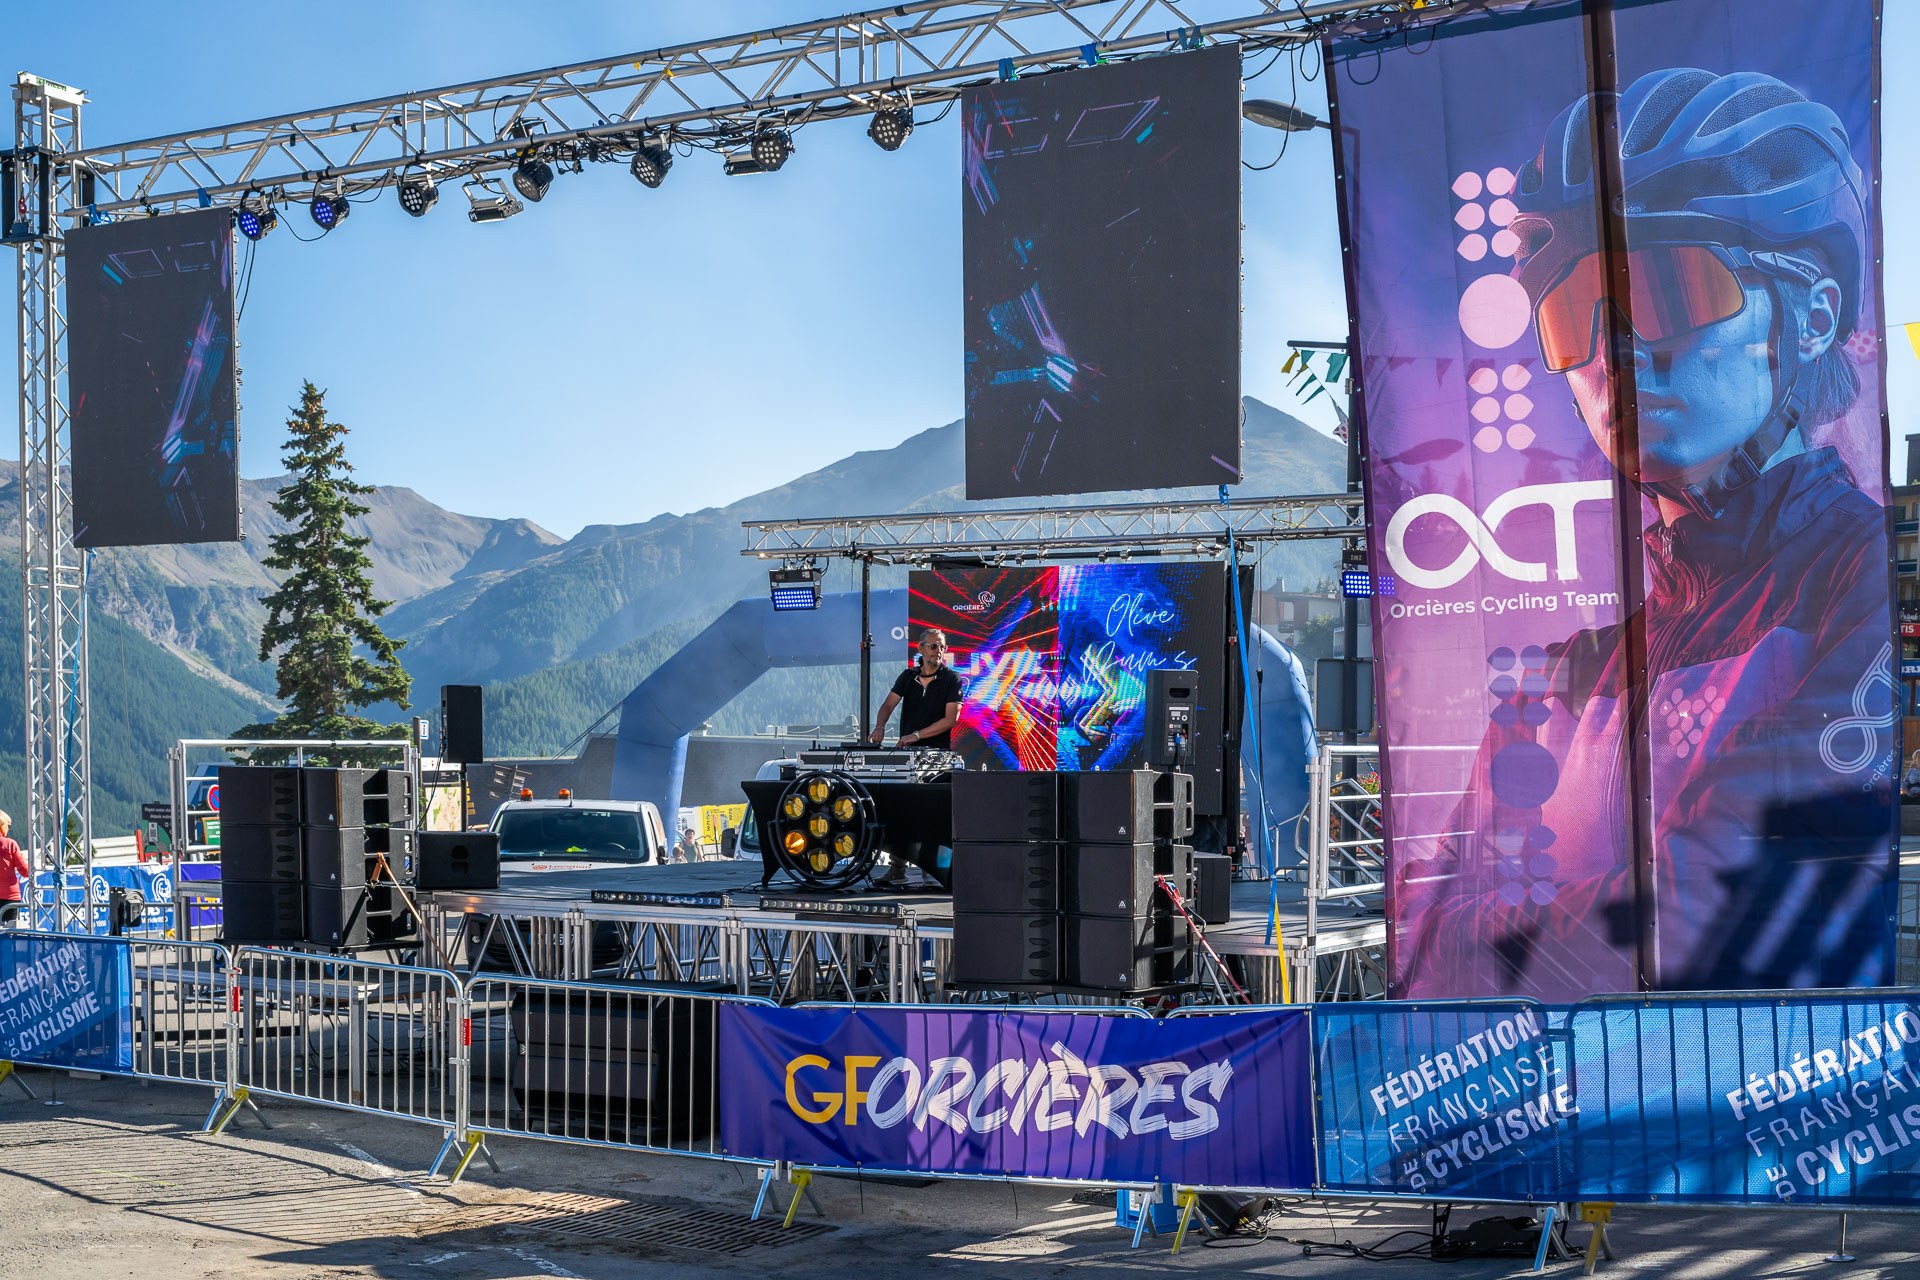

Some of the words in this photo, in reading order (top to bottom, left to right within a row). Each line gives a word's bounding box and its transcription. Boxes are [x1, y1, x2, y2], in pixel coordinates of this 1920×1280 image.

[1106, 593, 1175, 637] Olive
[1390, 600, 1476, 619] Orcières
[1481, 593, 1558, 615] Cycling
[1563, 591, 1620, 607] Team
[1862, 749, 1898, 793] Orcières
[0, 965, 91, 1034] FRANÇAISE
[20, 991, 100, 1052] CYCLISME
[1370, 1008, 1541, 1117] FÉDÉRATION
[1726, 1005, 1920, 1121] FÉDÉRATIO
[1388, 1045, 1562, 1153] FRANÇAISE
[1403, 1158, 1427, 1189] DE
[1425, 1084, 1581, 1179] CYCLISME
[1765, 1163, 1797, 1199] DE
